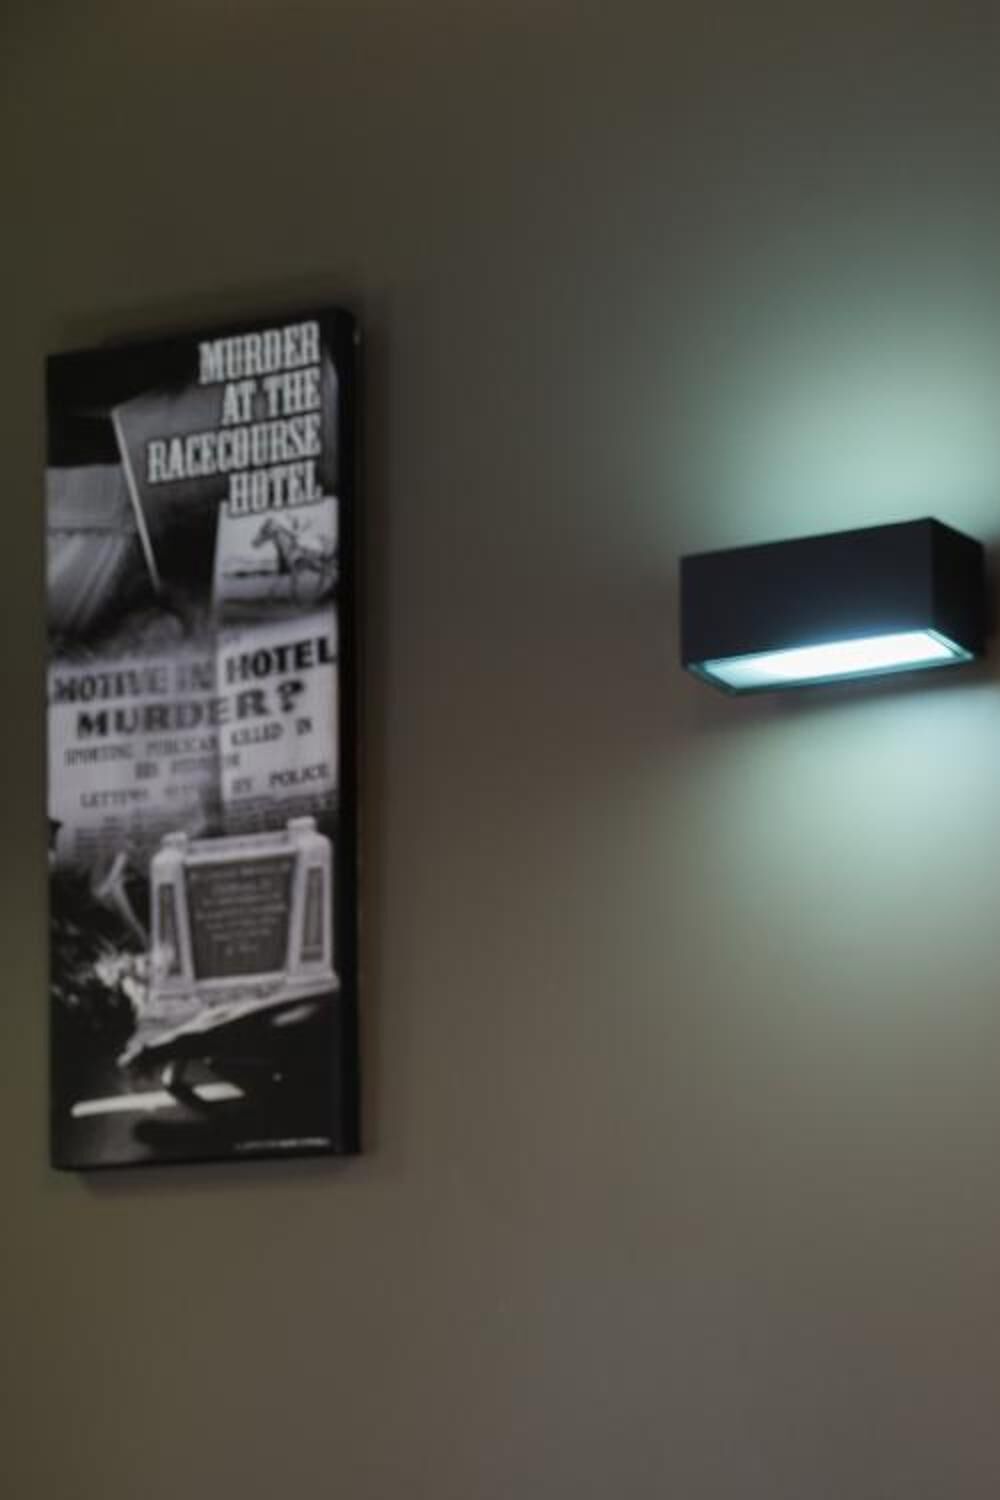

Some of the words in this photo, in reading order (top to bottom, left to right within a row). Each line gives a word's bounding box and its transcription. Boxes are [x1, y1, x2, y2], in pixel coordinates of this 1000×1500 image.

[198, 320, 320, 385] MURDER
[222, 379, 258, 426] AT
[262, 366, 321, 416] THE
[147, 413, 321, 483] RACECOURSE
[228, 460, 322, 515] HOTEL
[226, 635, 337, 685] HOTEL
